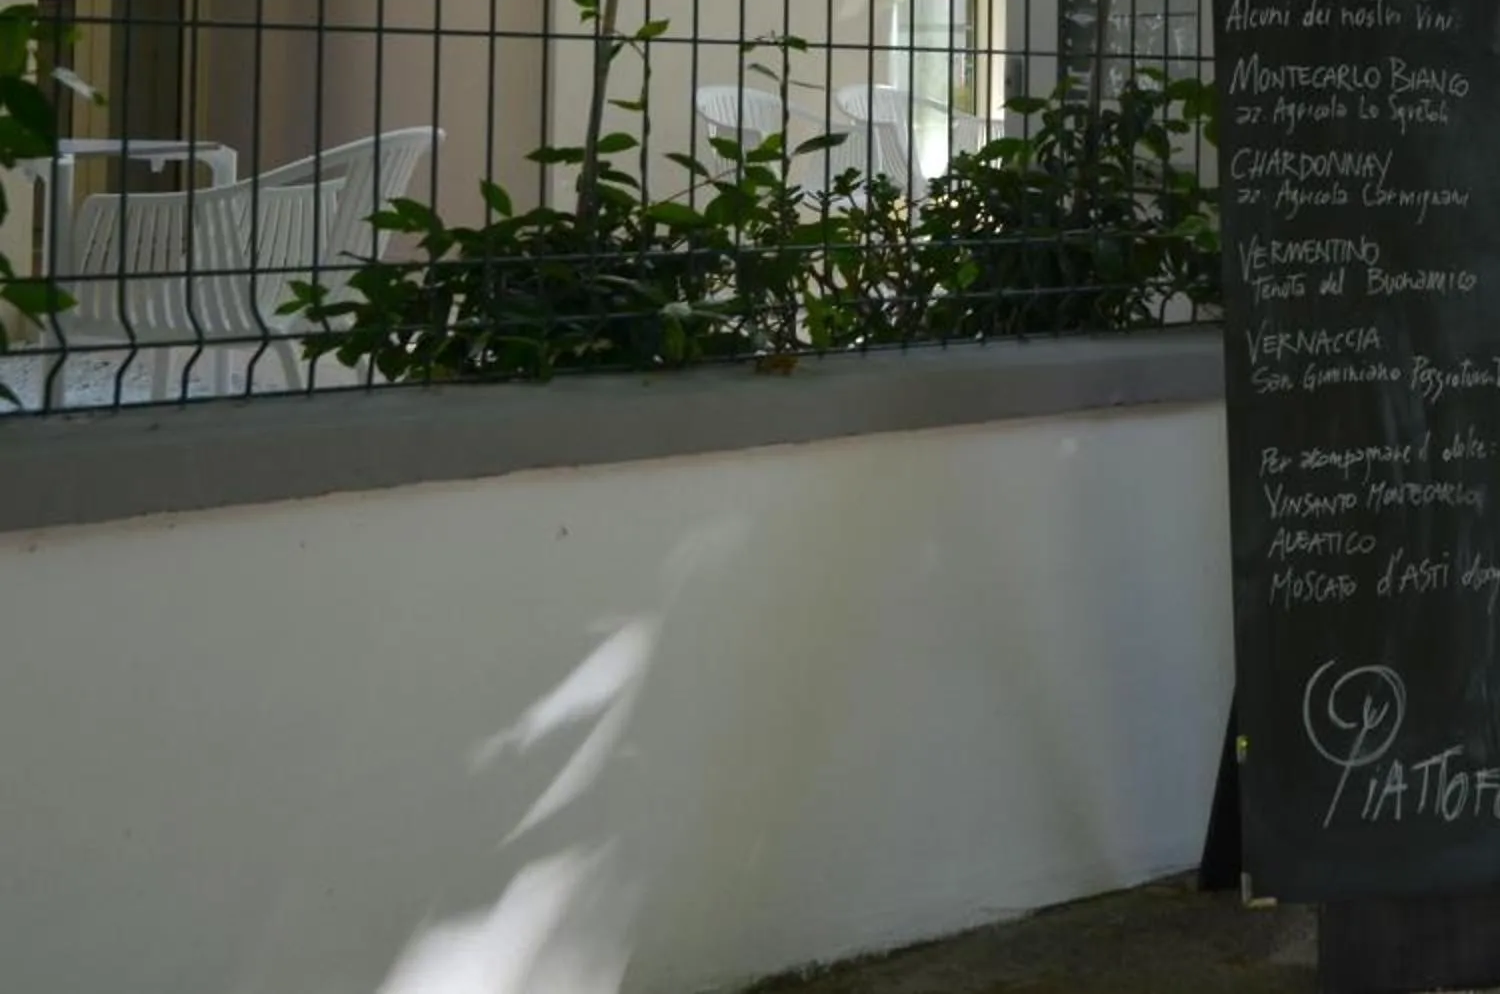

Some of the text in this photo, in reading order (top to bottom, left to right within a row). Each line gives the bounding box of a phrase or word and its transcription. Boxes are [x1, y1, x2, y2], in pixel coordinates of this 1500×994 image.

[1228, 51, 1470, 97] MONTECARLO BIANCO
[1230, 147, 1394, 187] CHARDONNAY
[1238, 233, 1381, 283] VERMENTINO
[1251, 273, 1306, 306] Tenuta
[1319, 268, 1345, 295] del
[1245, 318, 1382, 364] VERNACCIA
[1259, 446, 1292, 478] Per
[1268, 527, 1377, 561] ALEATICO
[1269, 567, 1358, 604] MOSCATO
